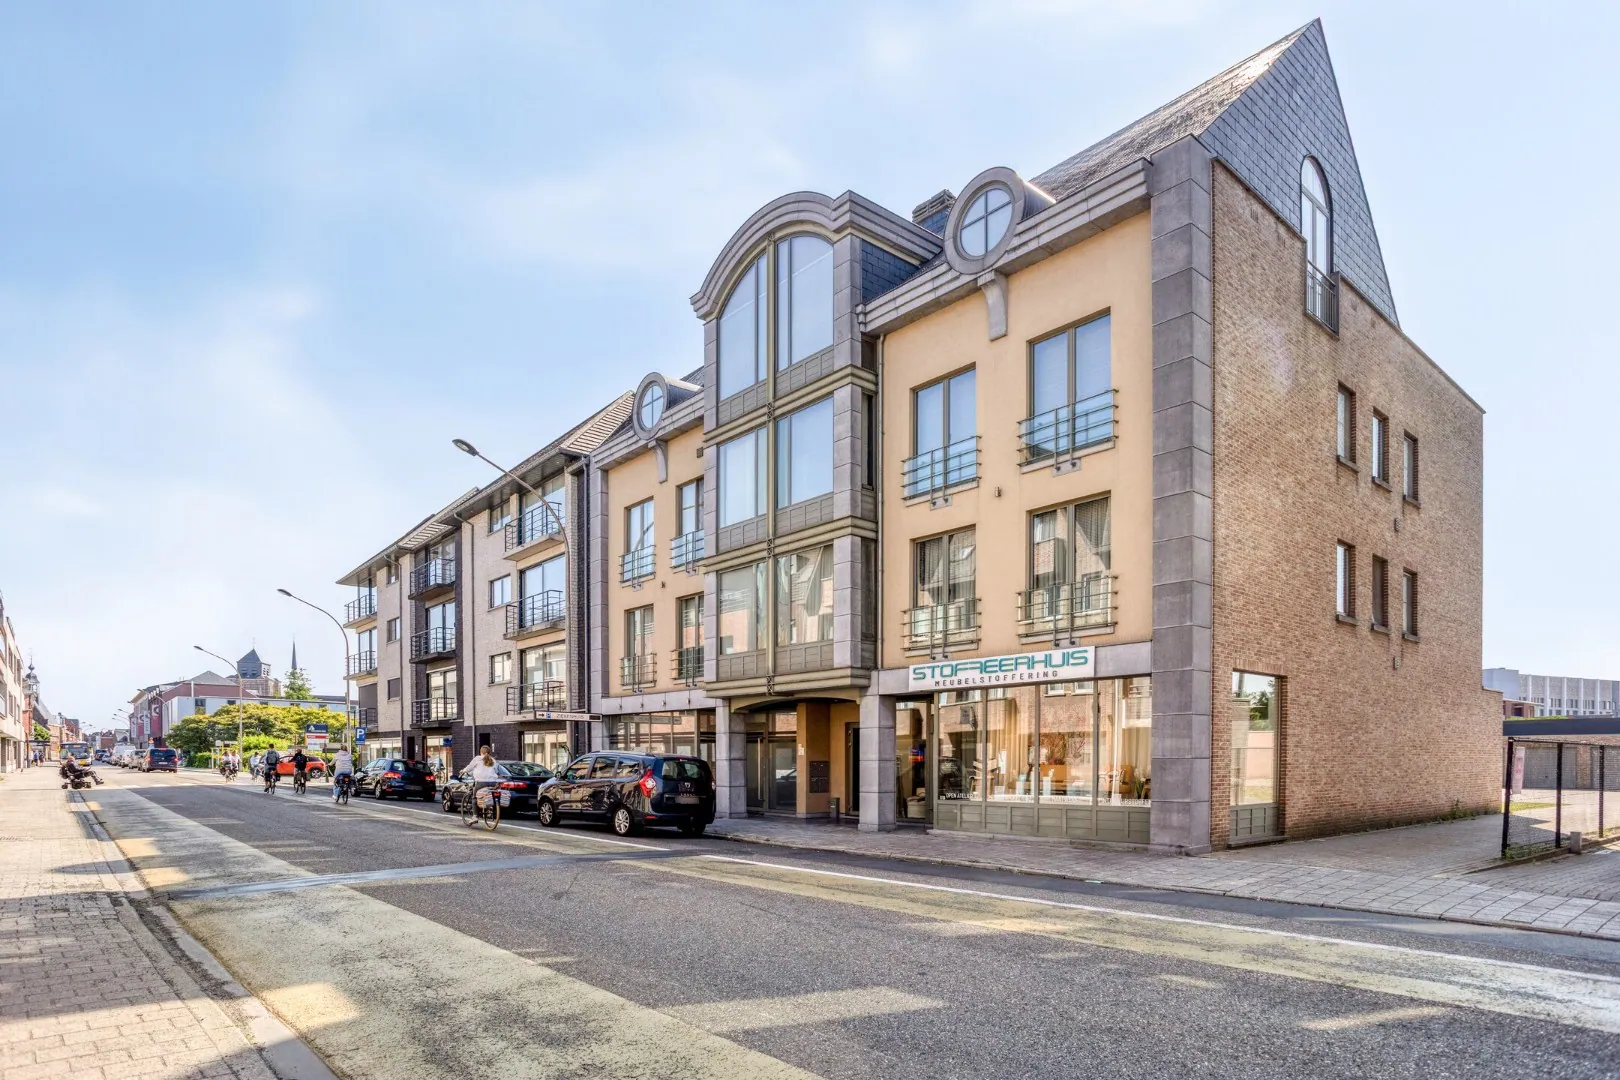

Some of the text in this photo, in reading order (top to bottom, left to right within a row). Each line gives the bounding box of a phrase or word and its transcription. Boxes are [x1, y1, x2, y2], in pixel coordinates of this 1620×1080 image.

[912, 649, 1088, 680] STOFFEERHUIS
[935, 670, 1059, 687] MEUBELSTOFFERING
[356, 729, 365, 739] P
